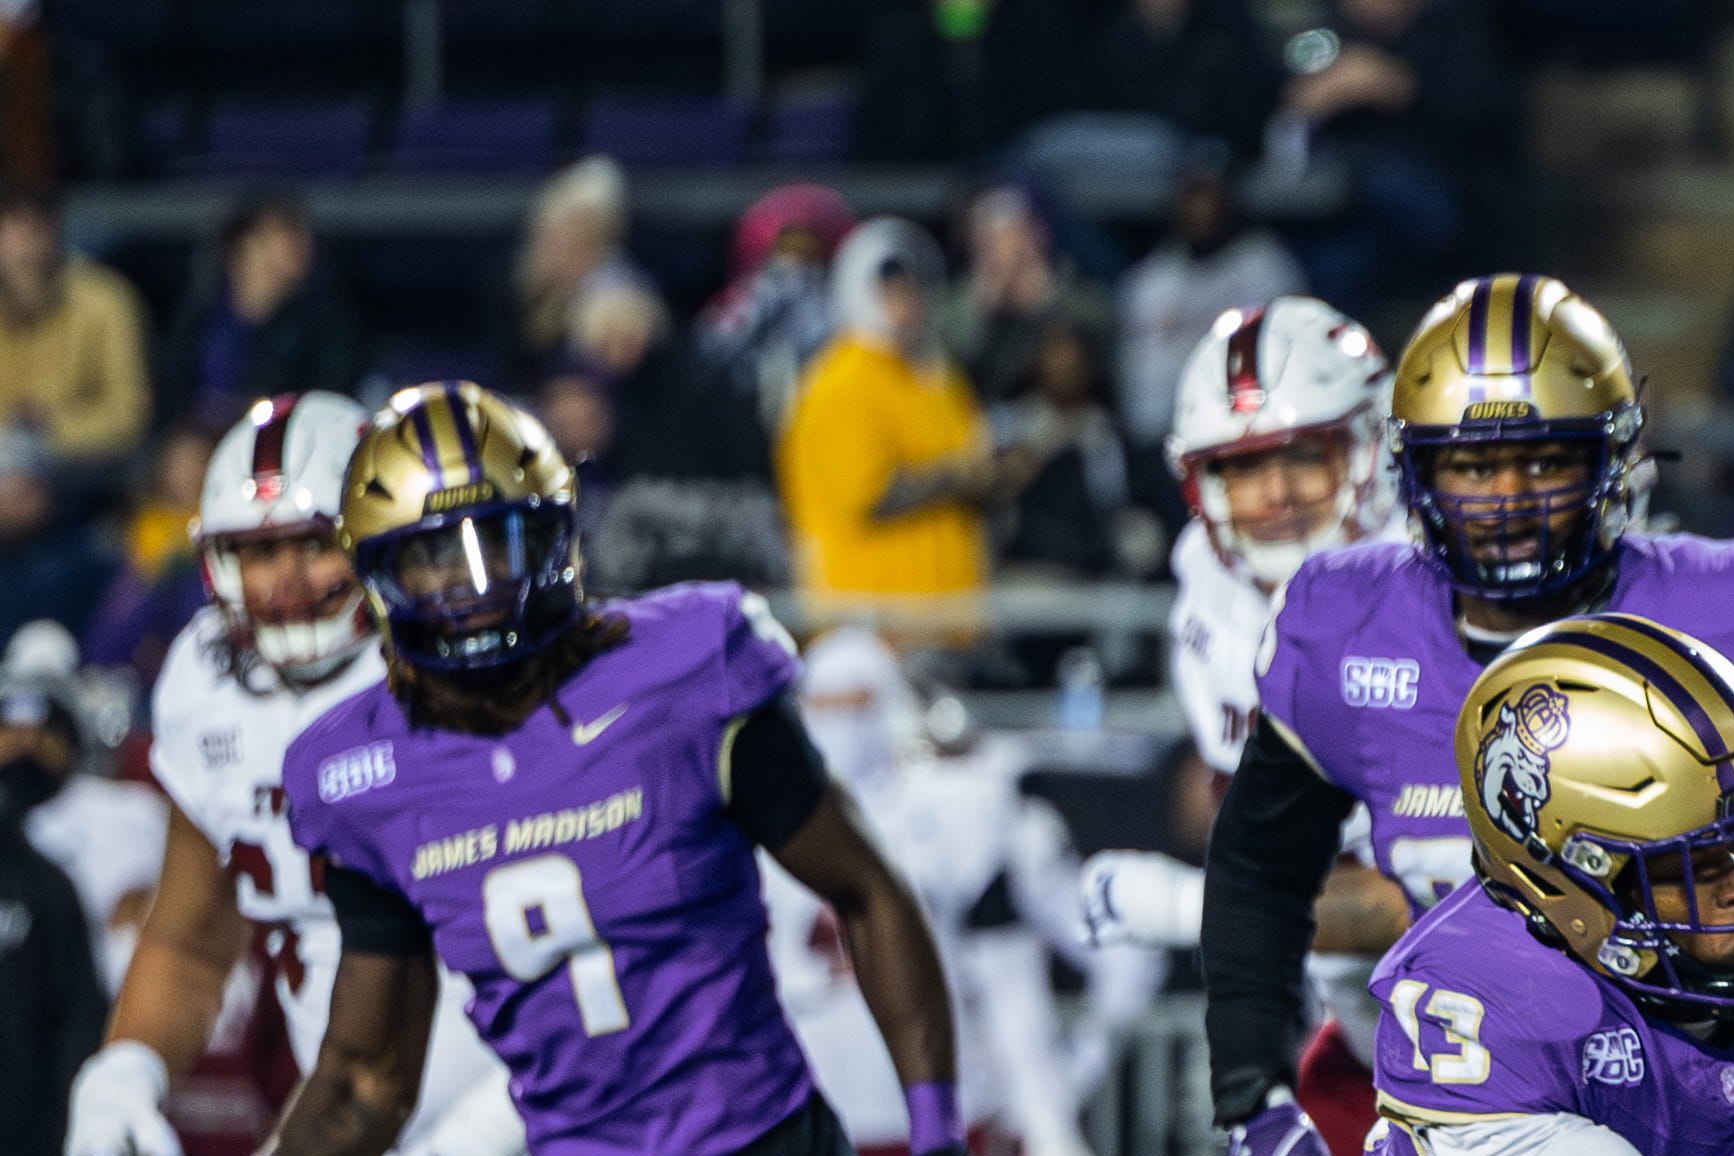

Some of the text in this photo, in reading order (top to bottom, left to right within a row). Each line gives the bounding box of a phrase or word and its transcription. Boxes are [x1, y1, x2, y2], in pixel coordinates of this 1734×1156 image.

[1470, 403, 1529, 419] DUKES
[1342, 656, 1419, 708] SBC
[411, 786, 643, 880] JAMES MADISON
[1392, 785, 1467, 817] JAME
[483, 855, 631, 1039] 9
[1390, 980, 1491, 1084] 13
